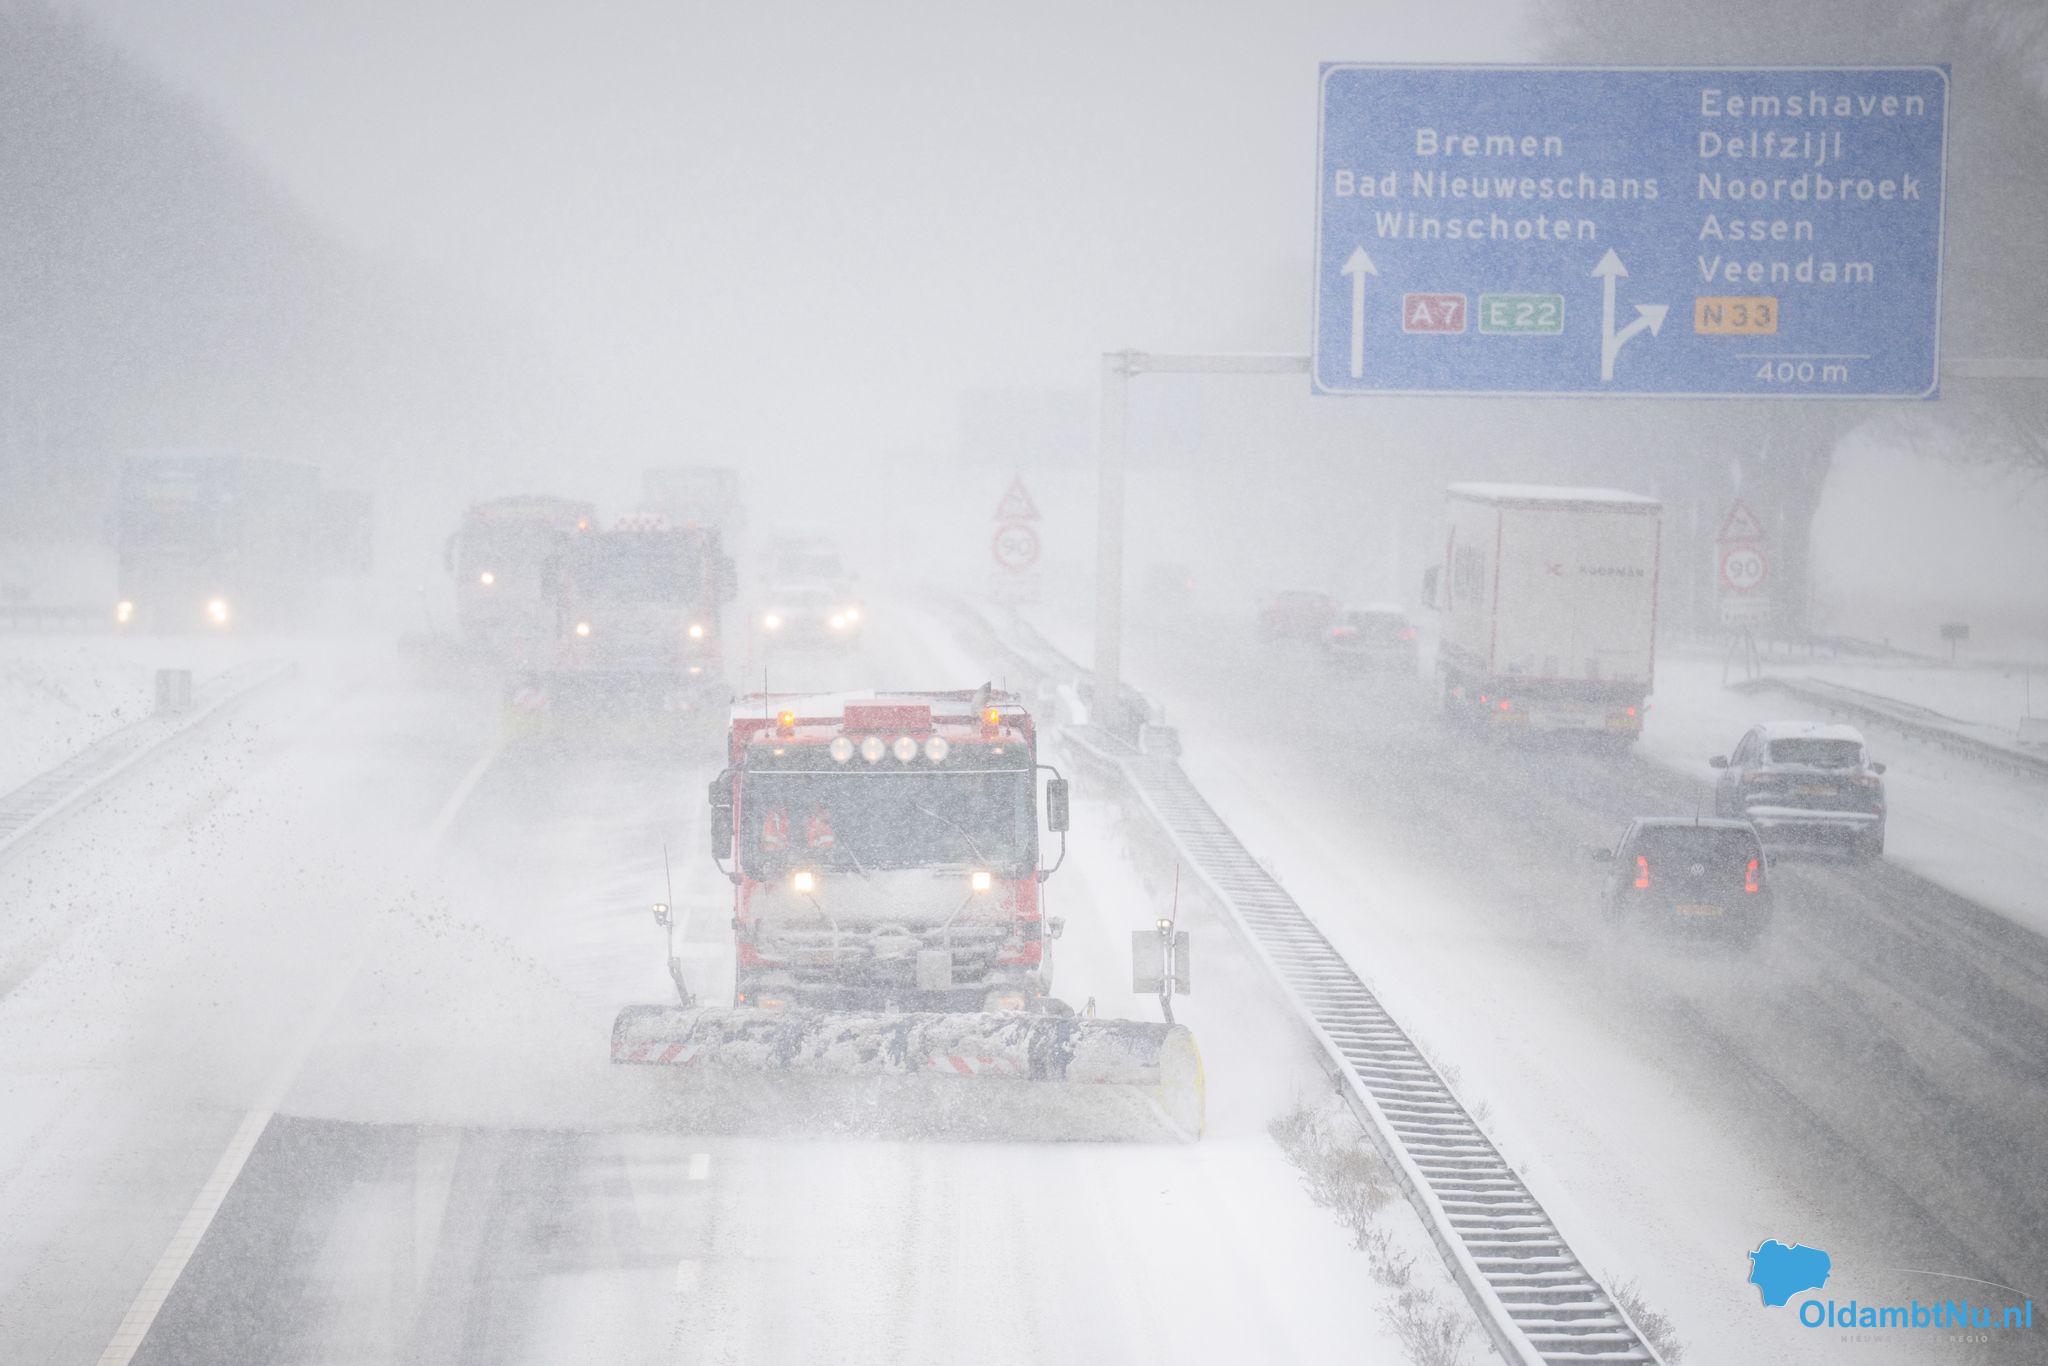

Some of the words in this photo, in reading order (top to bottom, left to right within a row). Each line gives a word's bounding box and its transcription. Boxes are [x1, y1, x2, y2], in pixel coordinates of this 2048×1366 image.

[1700, 88, 1924, 117] Eemshaven
[1416, 128, 1563, 157] Bremen
[1700, 131, 1841, 166] Delfzijl
[1335, 169, 1397, 198] Bad
[1412, 170, 1659, 200] Nieuweschans
[1699, 173, 1921, 200] Noordbroek
[1375, 211, 1597, 240] Winschoten
[1699, 214, 1813, 241] Assen
[1699, 255, 1874, 283] Veendam
[1729, 560, 1759, 578] 90
